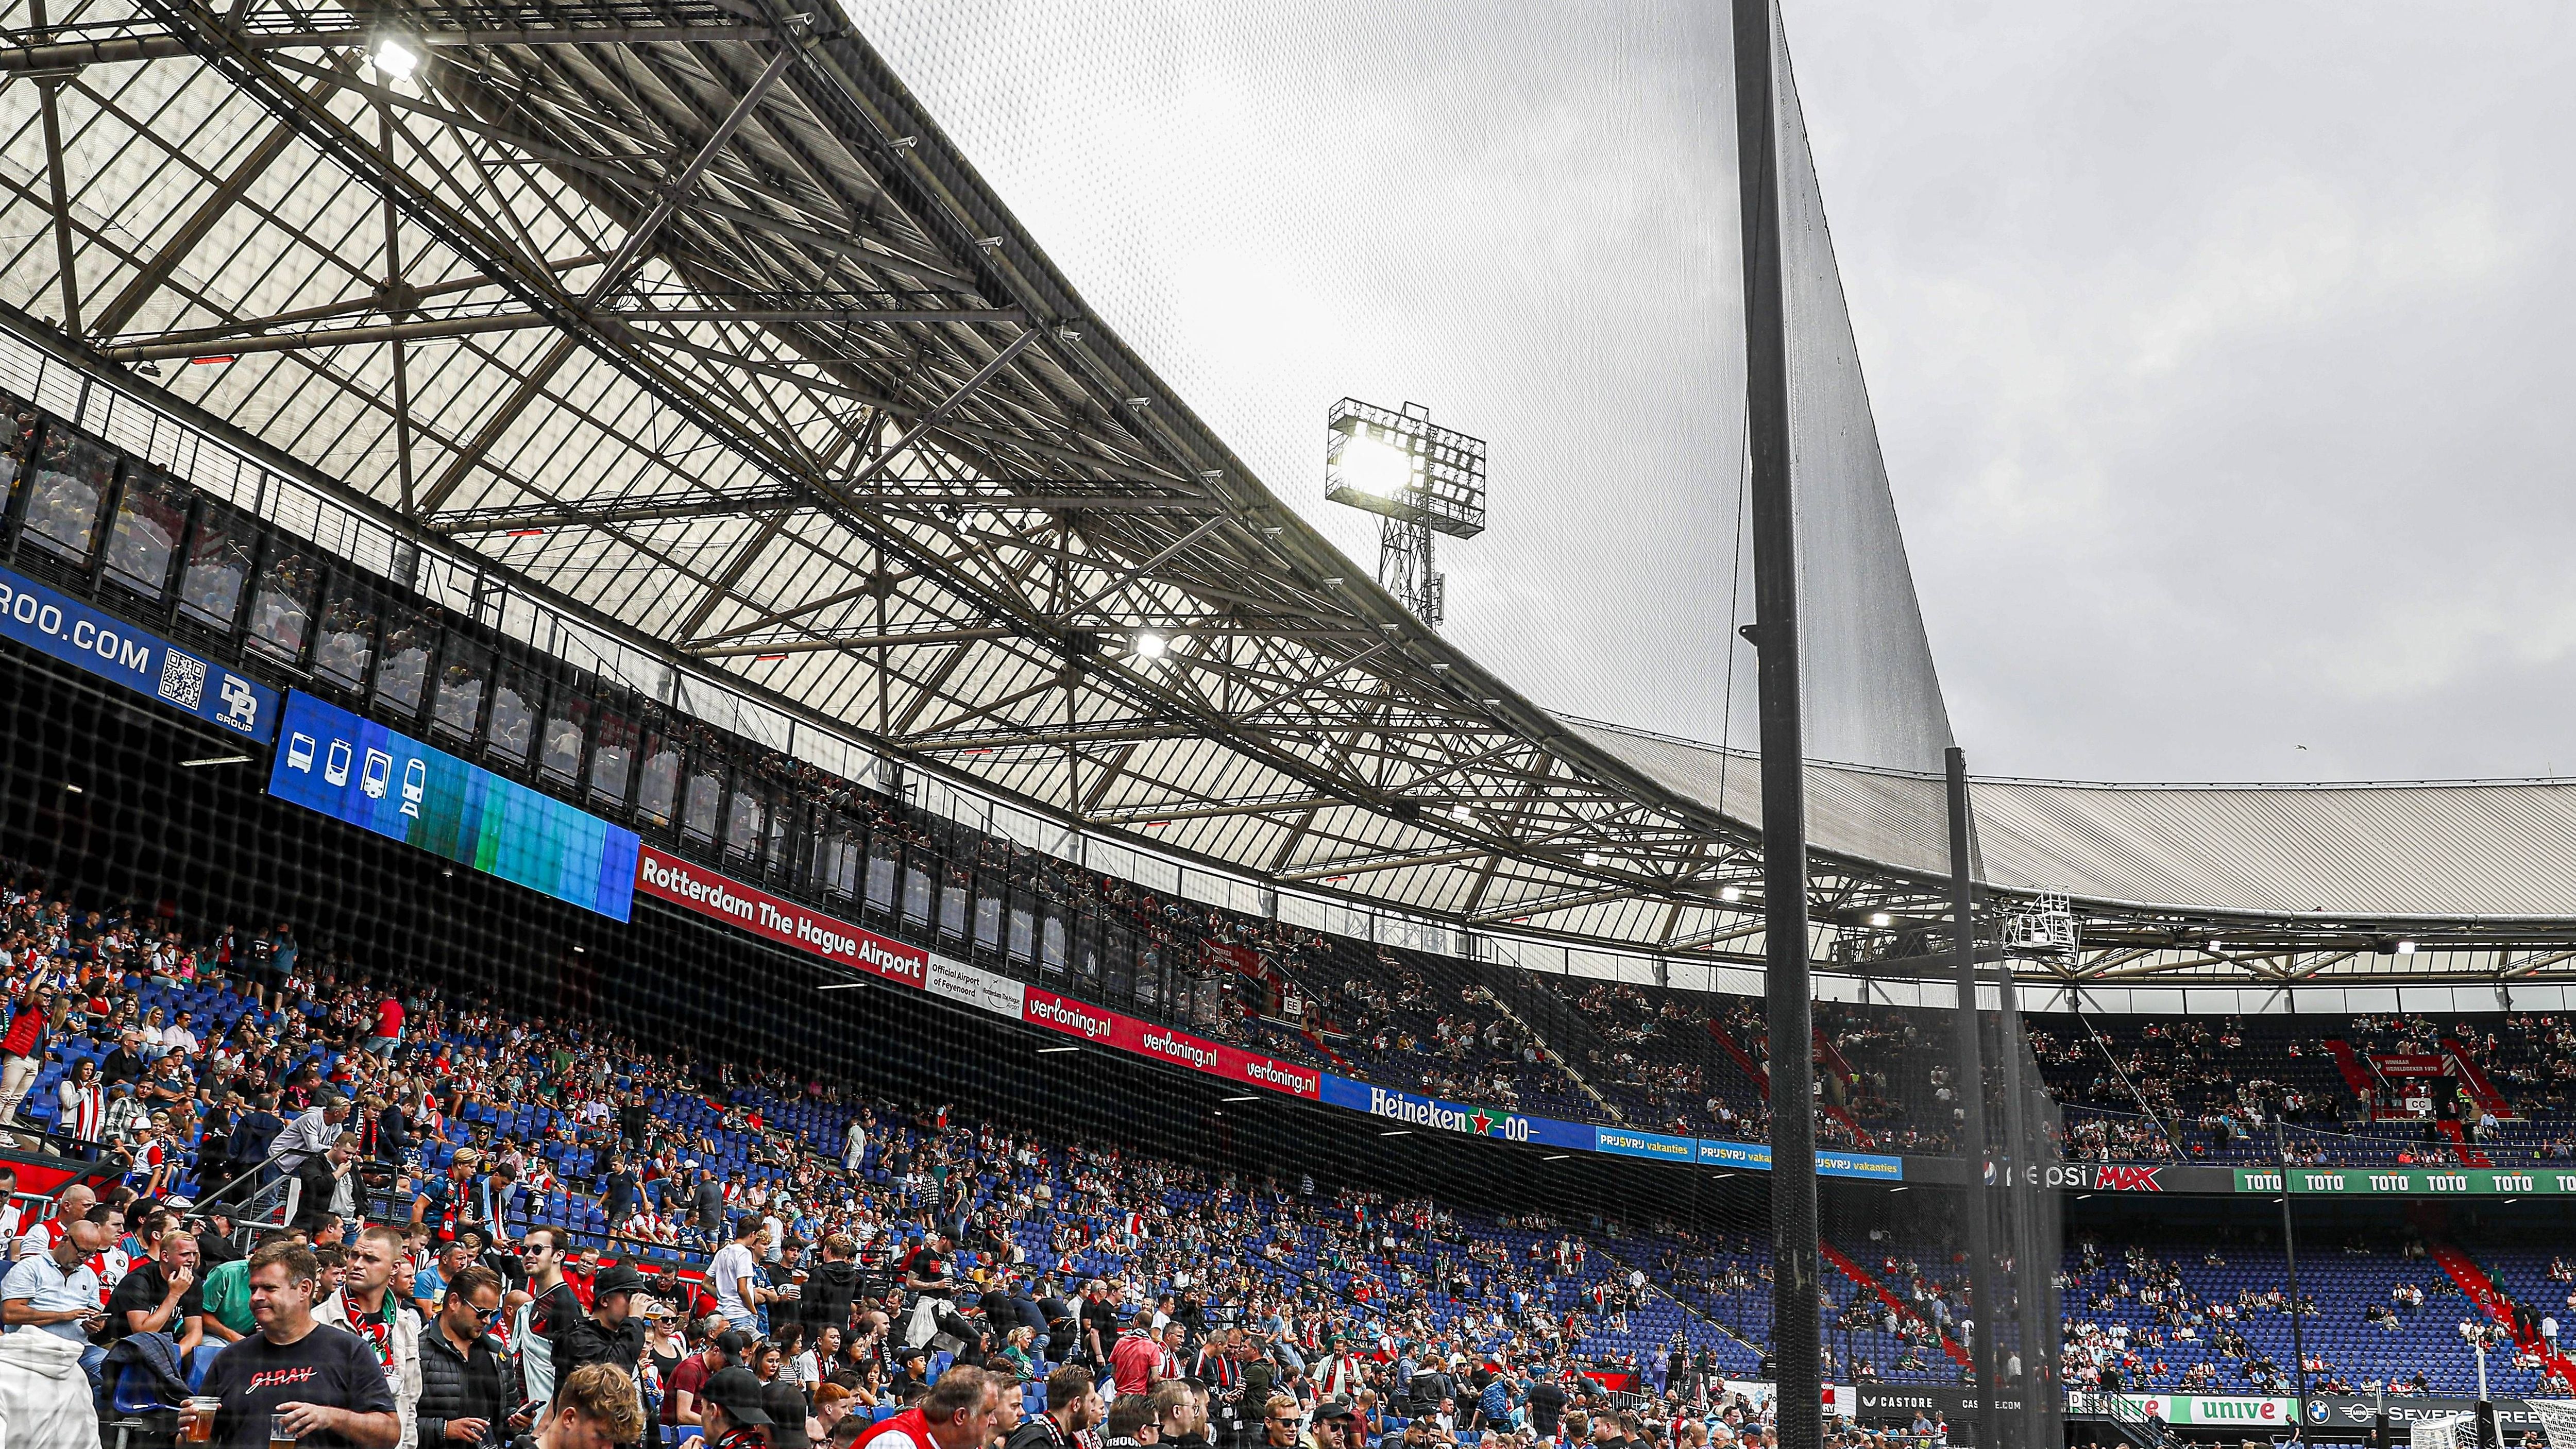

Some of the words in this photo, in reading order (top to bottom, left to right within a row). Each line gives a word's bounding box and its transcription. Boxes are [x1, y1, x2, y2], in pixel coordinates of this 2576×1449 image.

[216, 712, 252, 732] GROUP
[642, 857, 754, 920] Rotterdam
[758, 901, 793, 934] The
[797, 919, 855, 957] Hague
[858, 940, 921, 979] Airport
[932, 964, 956, 978] Official
[957, 972, 980, 986] Airport
[942, 980, 976, 997] Feyenoord
[983, 987, 1001, 998] Rotterdam
[1287, 1001, 1297, 1011] EE
[1030, 997, 1111, 1037] verloning.nl
[1143, 1031, 1217, 1067] verloning.nl
[1247, 1060, 1315, 1093] verloning.nl
[1370, 1087, 1467, 1133] Heineken
[2412, 1100, 2426, 1109] CC
[1646, 1142, 1688, 1154] vakanties
[1748, 1153, 1771, 1163] vaka
[1854, 1163, 1897, 1173] vakanties
[2094, 1165, 2163, 1191] MAX
[2244, 1174, 2282, 1190] TOTO
[2305, 1175, 2344, 1191] TOTO
[2369, 1175, 2409, 1191] TOTO
[2426, 1175, 2466, 1191] TOTO
[2492, 1175, 2533, 1191] TOTO
[443, 1220, 454, 1232] 12
[1880, 1396, 1932, 1408] CASTORE
[2072, 1394, 2079, 1404] D
[2201, 1395, 2275, 1420] univé
